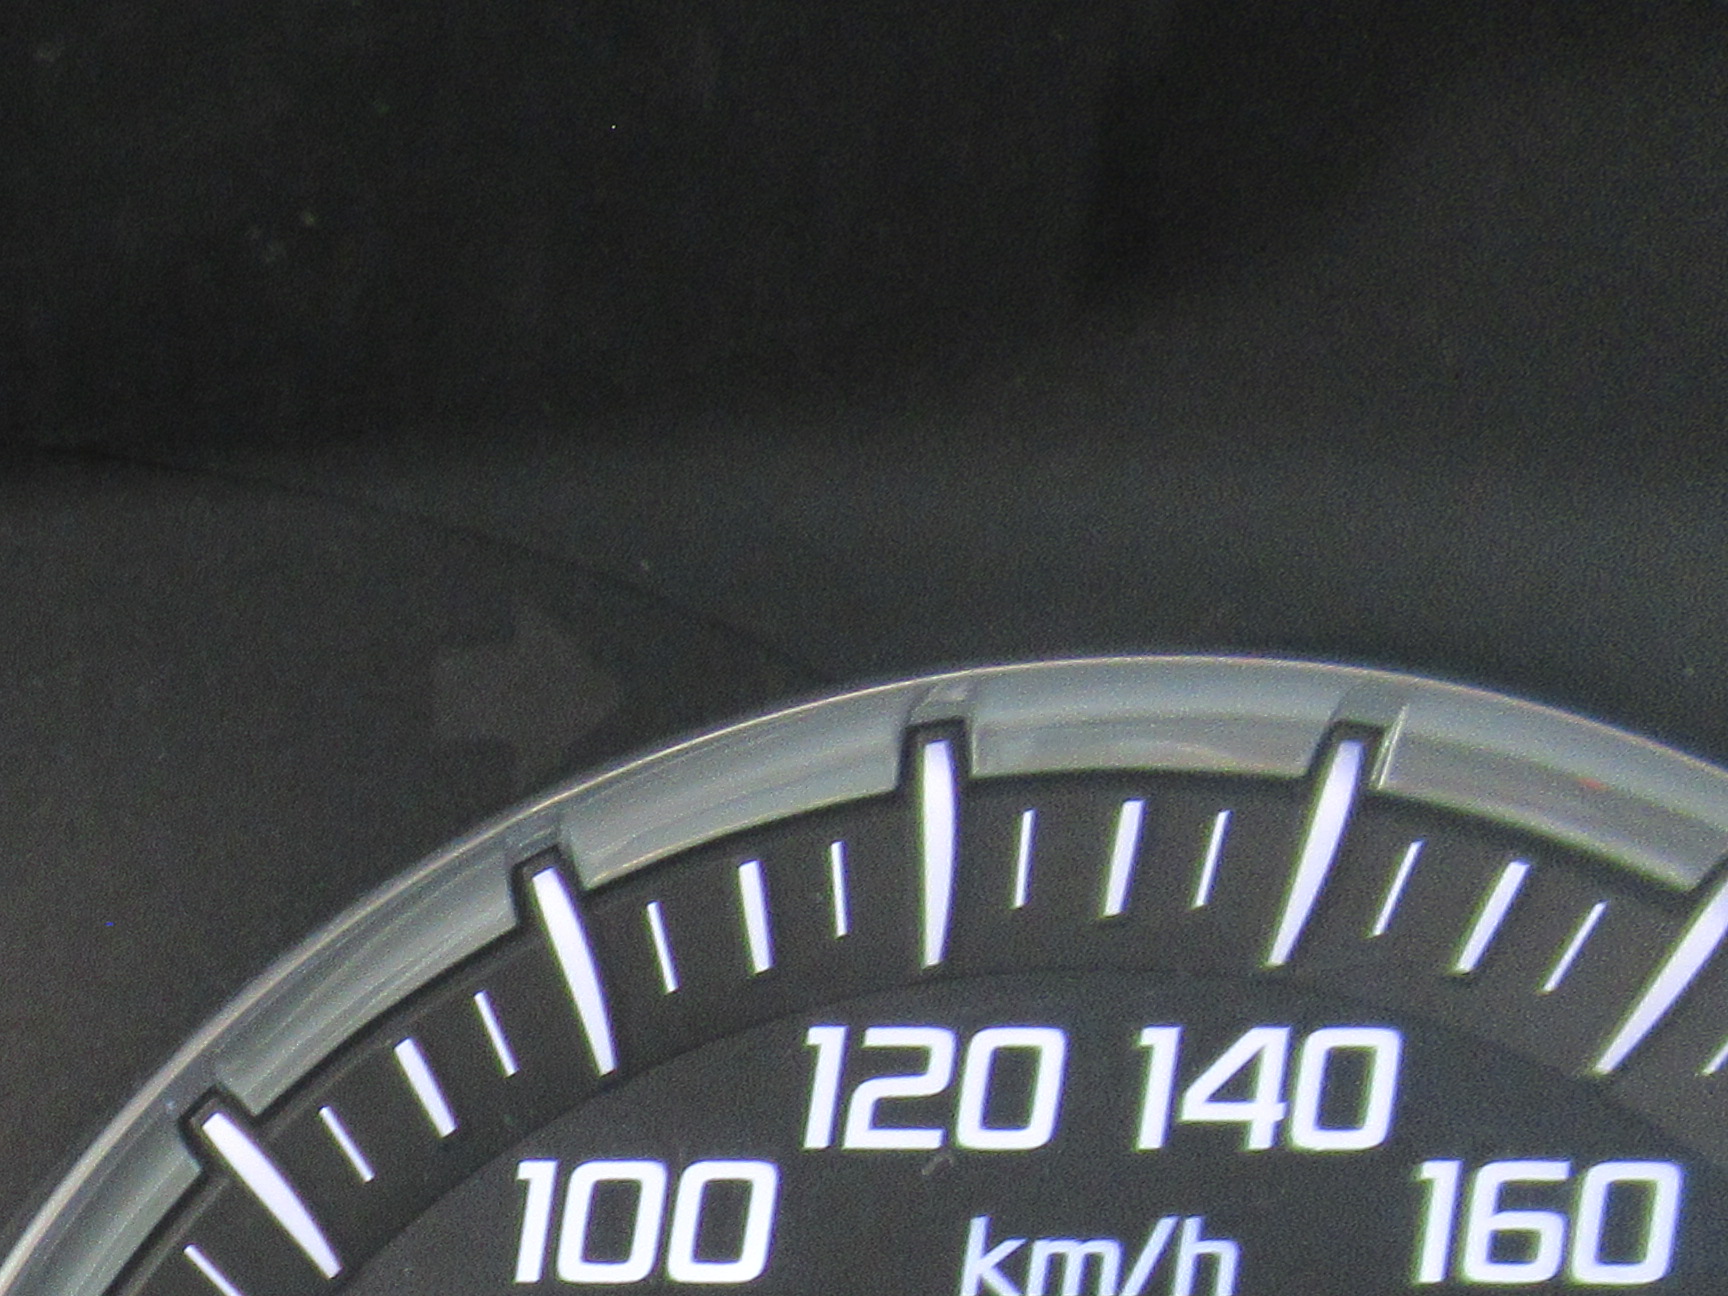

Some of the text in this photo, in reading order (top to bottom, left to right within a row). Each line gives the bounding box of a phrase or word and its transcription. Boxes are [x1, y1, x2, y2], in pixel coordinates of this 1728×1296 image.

[802, 1024, 1068, 1152] 120
[1134, 1024, 1403, 1153] 140
[514, 1159, 780, 1285] 100
[1415, 1159, 1683, 1286] 160
